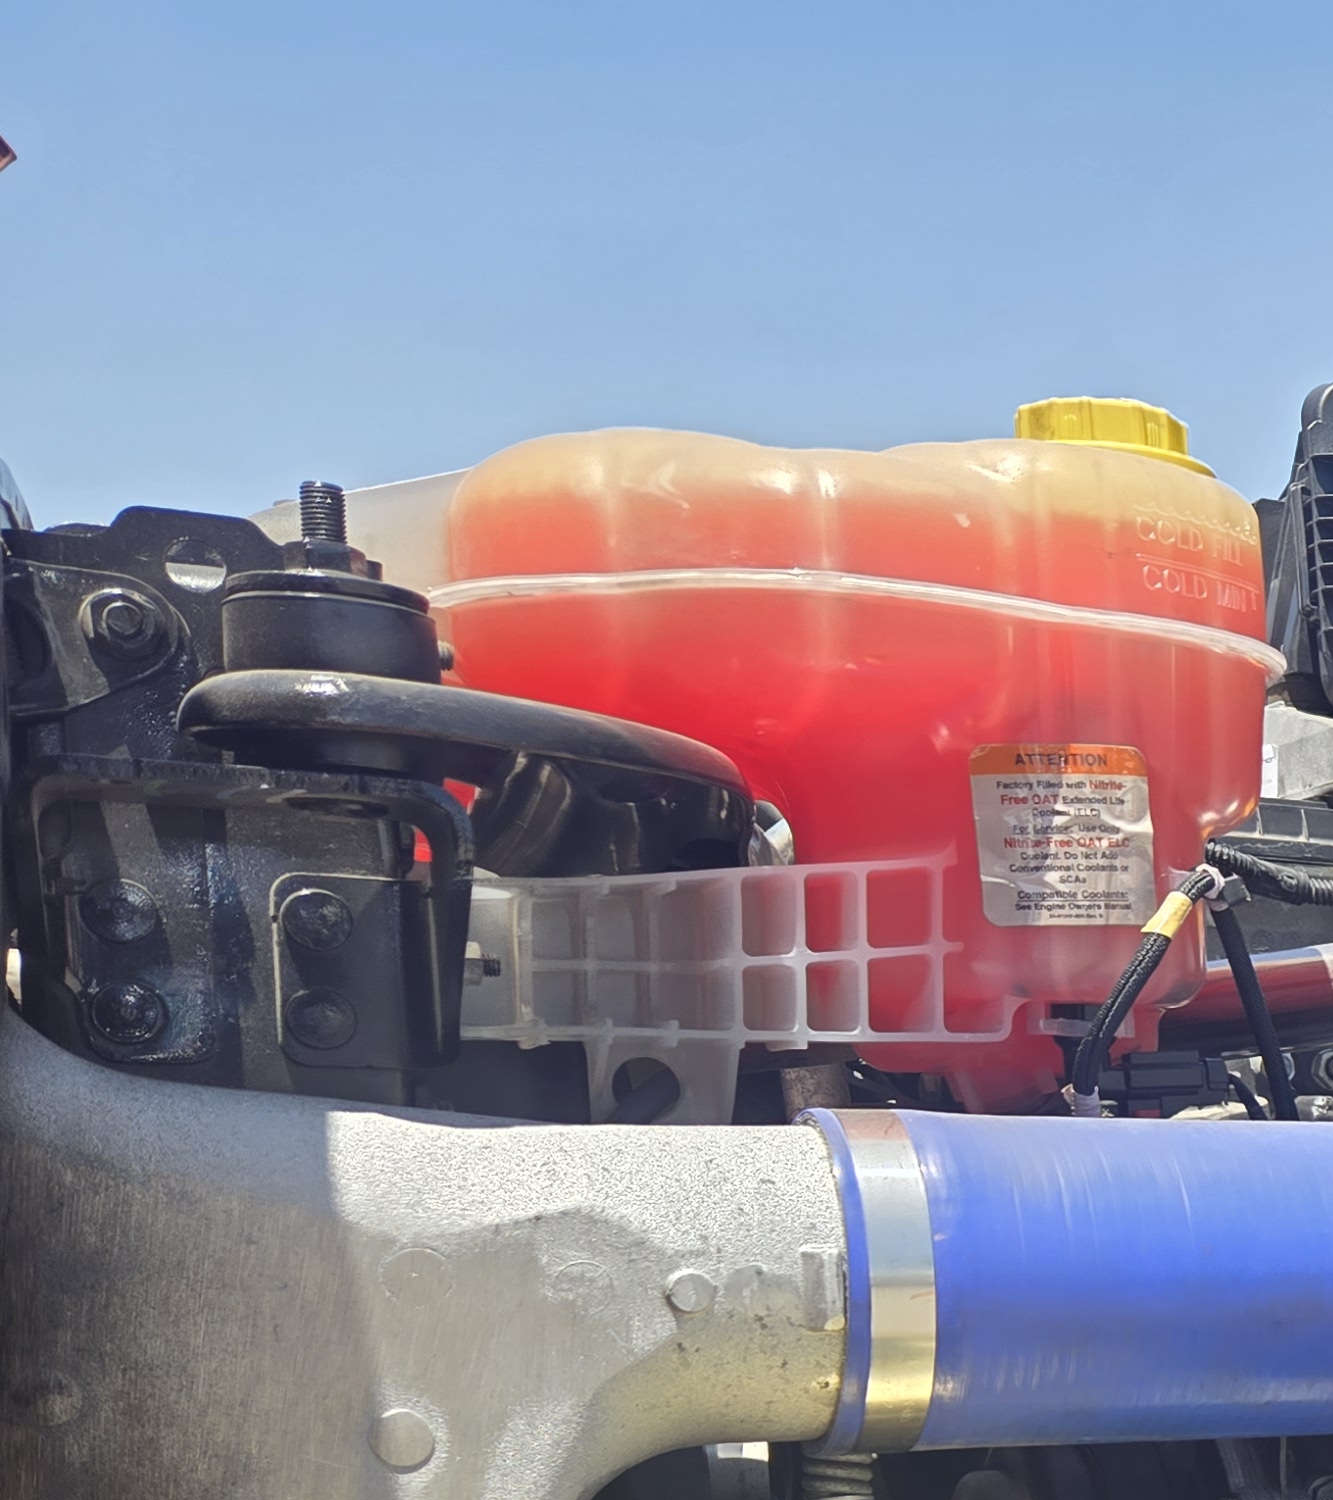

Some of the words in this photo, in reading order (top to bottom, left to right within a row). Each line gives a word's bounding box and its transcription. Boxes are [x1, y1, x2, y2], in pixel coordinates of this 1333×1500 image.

[1136, 516, 1203, 551] COLD
[1143, 565, 1207, 599] COLD
[1015, 753, 1108, 766] ATTENTION
[996, 781, 1033, 790] Factory
[1036, 780, 1063, 789] Filled
[1066, 780, 1087, 789] with
[1001, 794, 1029, 805] Free
[1032, 794, 1060, 805] OAT
[1062, 795, 1107, 805] Extended
[1078, 824, 1096, 832] Use
[1099, 824, 1120, 834] Only
[1077, 837, 1104, 848] OAT
[1107, 838, 1130, 847] ELC
[1064, 851, 1078, 860] Do
[1081, 851, 1098, 860] Not
[1100, 850, 1118, 859] Add
[1009, 864, 1074, 873] Conventional
[1077, 863, 1118, 872] Coolants
[1059, 875, 1087, 884] SCAs
[1017, 890, 1078, 900] Compatible
[1015, 903, 1032, 911] See
[1034, 902, 1066, 912] Engine
[1104, 902, 1132, 911] Manual
